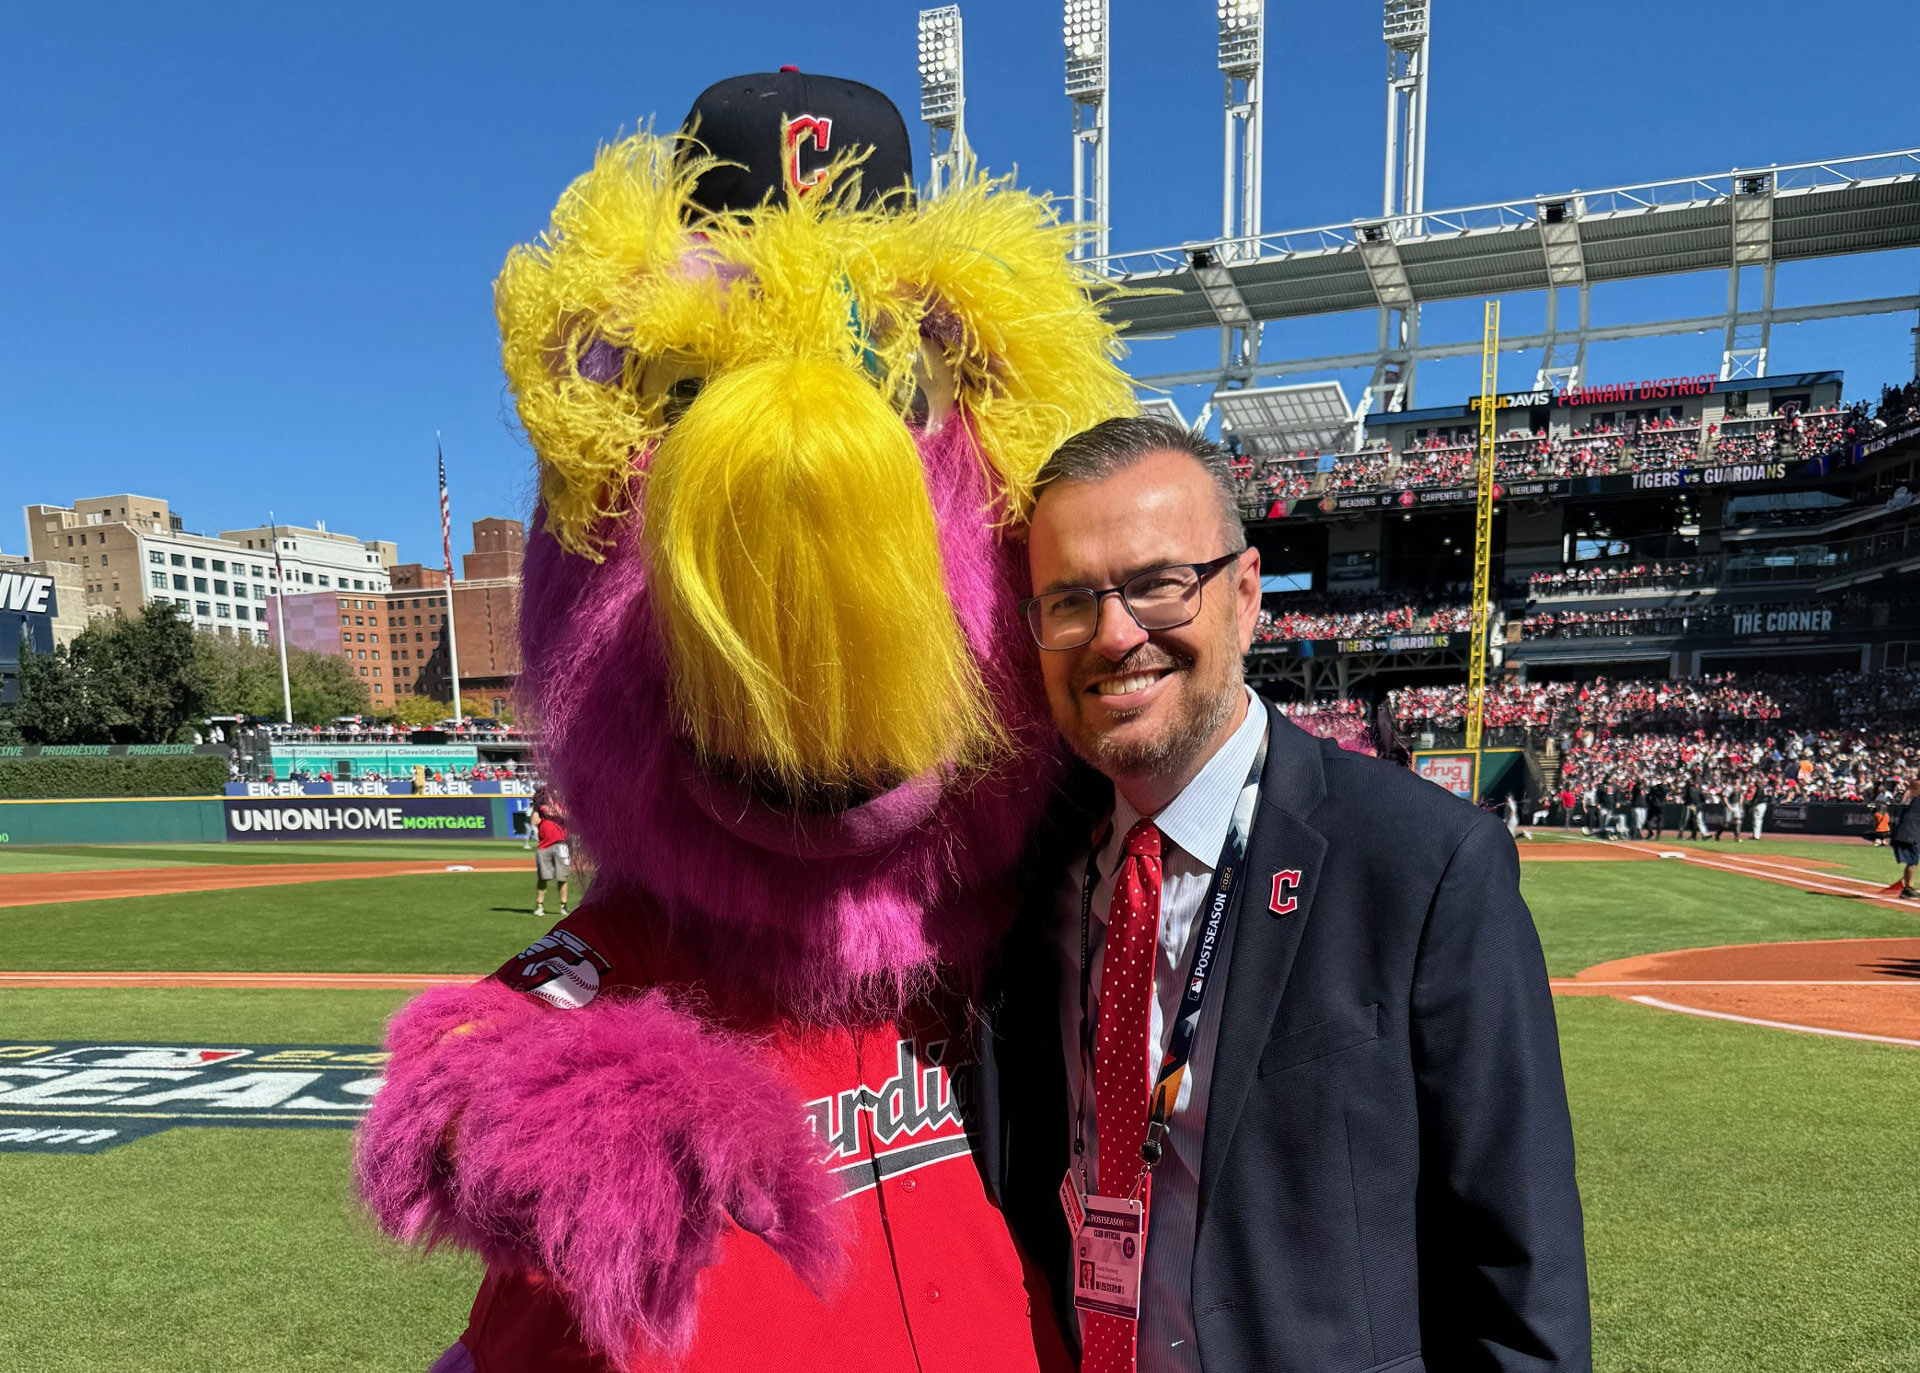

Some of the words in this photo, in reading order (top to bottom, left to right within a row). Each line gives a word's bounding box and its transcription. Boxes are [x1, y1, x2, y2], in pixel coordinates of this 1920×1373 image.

[783, 114, 833, 199] C
[1470, 390, 1550, 411] PULDAVIS
[1557, 381, 1636, 408] PENNANT
[1639, 374, 1718, 400] DISTRICT
[1632, 471, 1680, 489] TIGERS
[1683, 474, 1700, 484] vs
[1703, 463, 1786, 484] GUARDIANS
[1420, 492, 1463, 502] CARPENTER
[1509, 483, 1544, 496] VIERLING
[1339, 496, 1376, 509] MEADOWS
[1732, 613, 1762, 635] THE
[1766, 610, 1832, 632] CORNER
[1337, 637, 1373, 654] TIGERS
[1375, 641, 1387, 650] vs
[1389, 635, 1449, 651] GUARDIANS
[39, 744, 111, 756] PROGRESSIVE
[126, 744, 196, 756] PROGRESSIVE
[323, 748, 347, 756] Health
[398, 748, 435, 756] Cleveland
[436, 748, 474, 756] Guardians
[1422, 758, 1462, 780] drug
[403, 815, 486, 830] MORTGAGE
[1269, 869, 1302, 915] C
[1194, 892, 1227, 977] POSTSEASON
[1220, 867, 1233, 892] 2024
[1090, 1213, 1124, 1227] POSTSEASON
